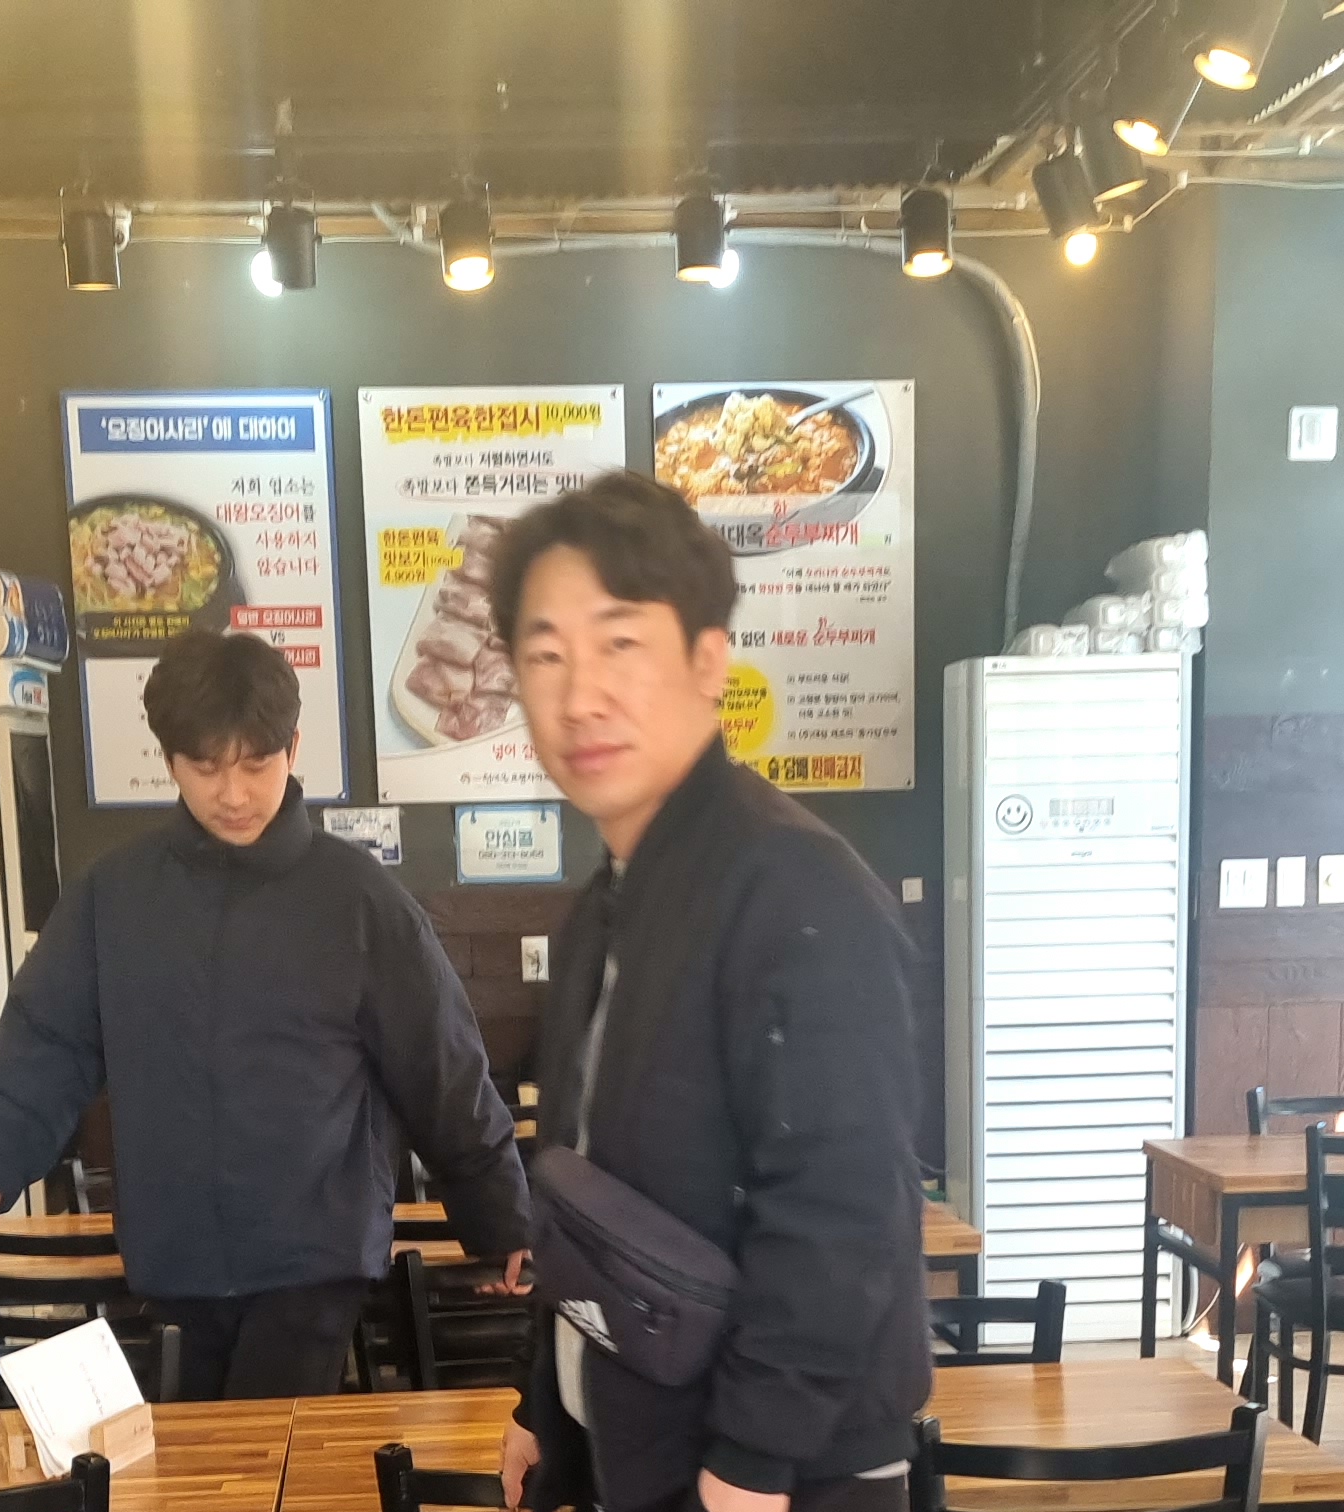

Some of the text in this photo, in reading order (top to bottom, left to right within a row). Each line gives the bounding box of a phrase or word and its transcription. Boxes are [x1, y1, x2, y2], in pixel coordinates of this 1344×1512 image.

[544, 402, 601, 422] 10,000원
[215, 502, 317, 524] 대왕오징어를
[255, 530, 318, 550] 사용하지
[256, 556, 320, 577] 않습니다
